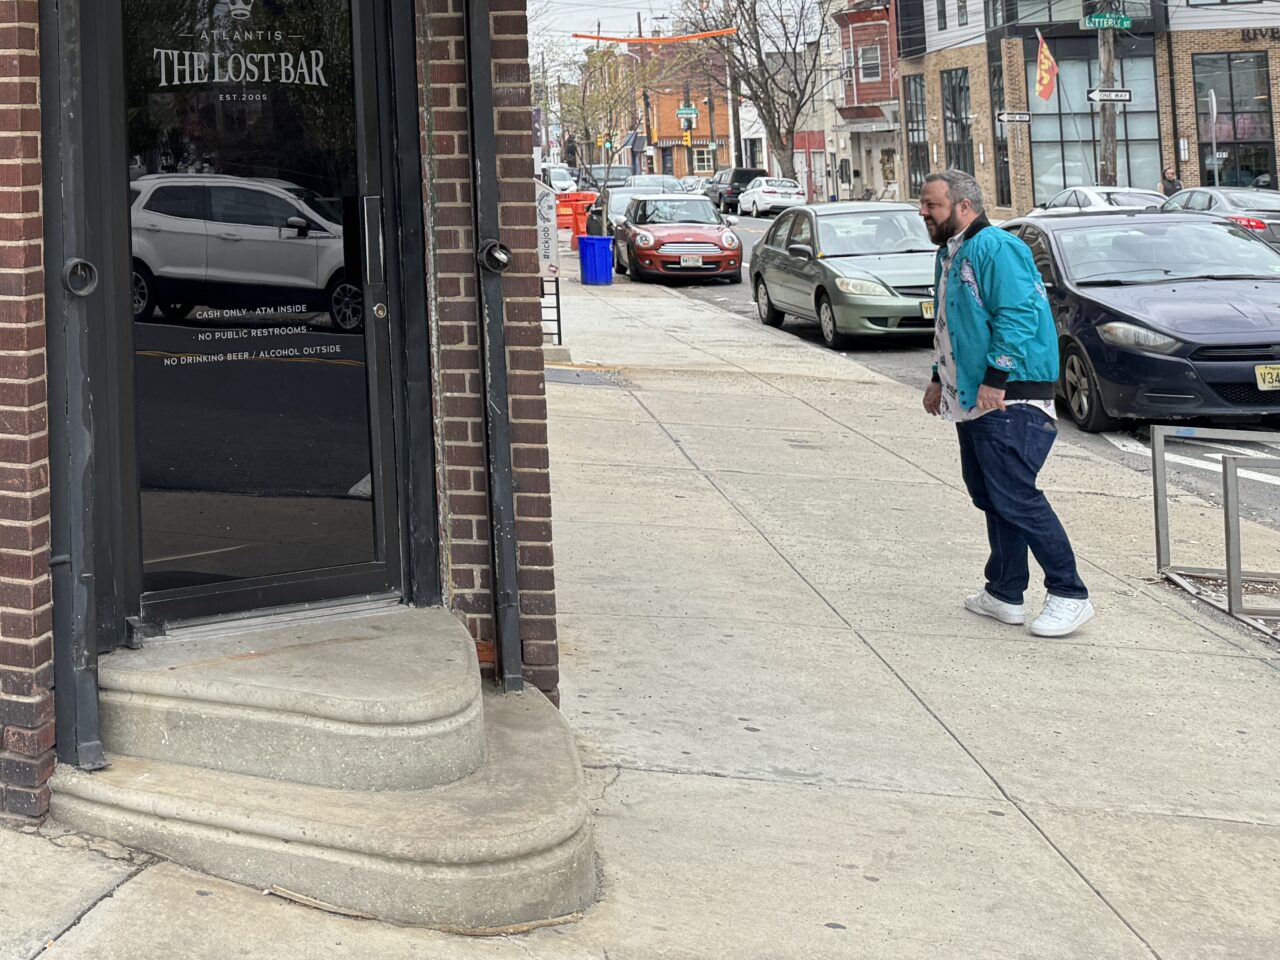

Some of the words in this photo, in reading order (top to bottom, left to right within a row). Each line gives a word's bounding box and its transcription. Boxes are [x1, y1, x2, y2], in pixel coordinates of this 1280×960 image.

[200, 30, 283, 41] ATLANTIS
[153, 48, 209, 87] THE
[212, 52, 276, 83] LOST
[279, 49, 328, 87] BAR
[541, 227, 551, 259] #rickjob
[196, 310, 220, 319] CASH
[223, 308, 247, 317] ONLY
[255, 306, 275, 315] ATM
[277, 304, 307, 313] INSIDE
[198, 332, 212, 341] NO
[215, 329, 248, 340] PUBLIC
[251, 325, 307, 337] RESTROOMS
[164, 357, 178, 366] NO
[180, 353, 224, 364] DRINKING
[227, 351, 249, 361] BEER
[259, 347, 300, 358] ALCOHOL
[302, 345, 341, 355] OUTSIDE
